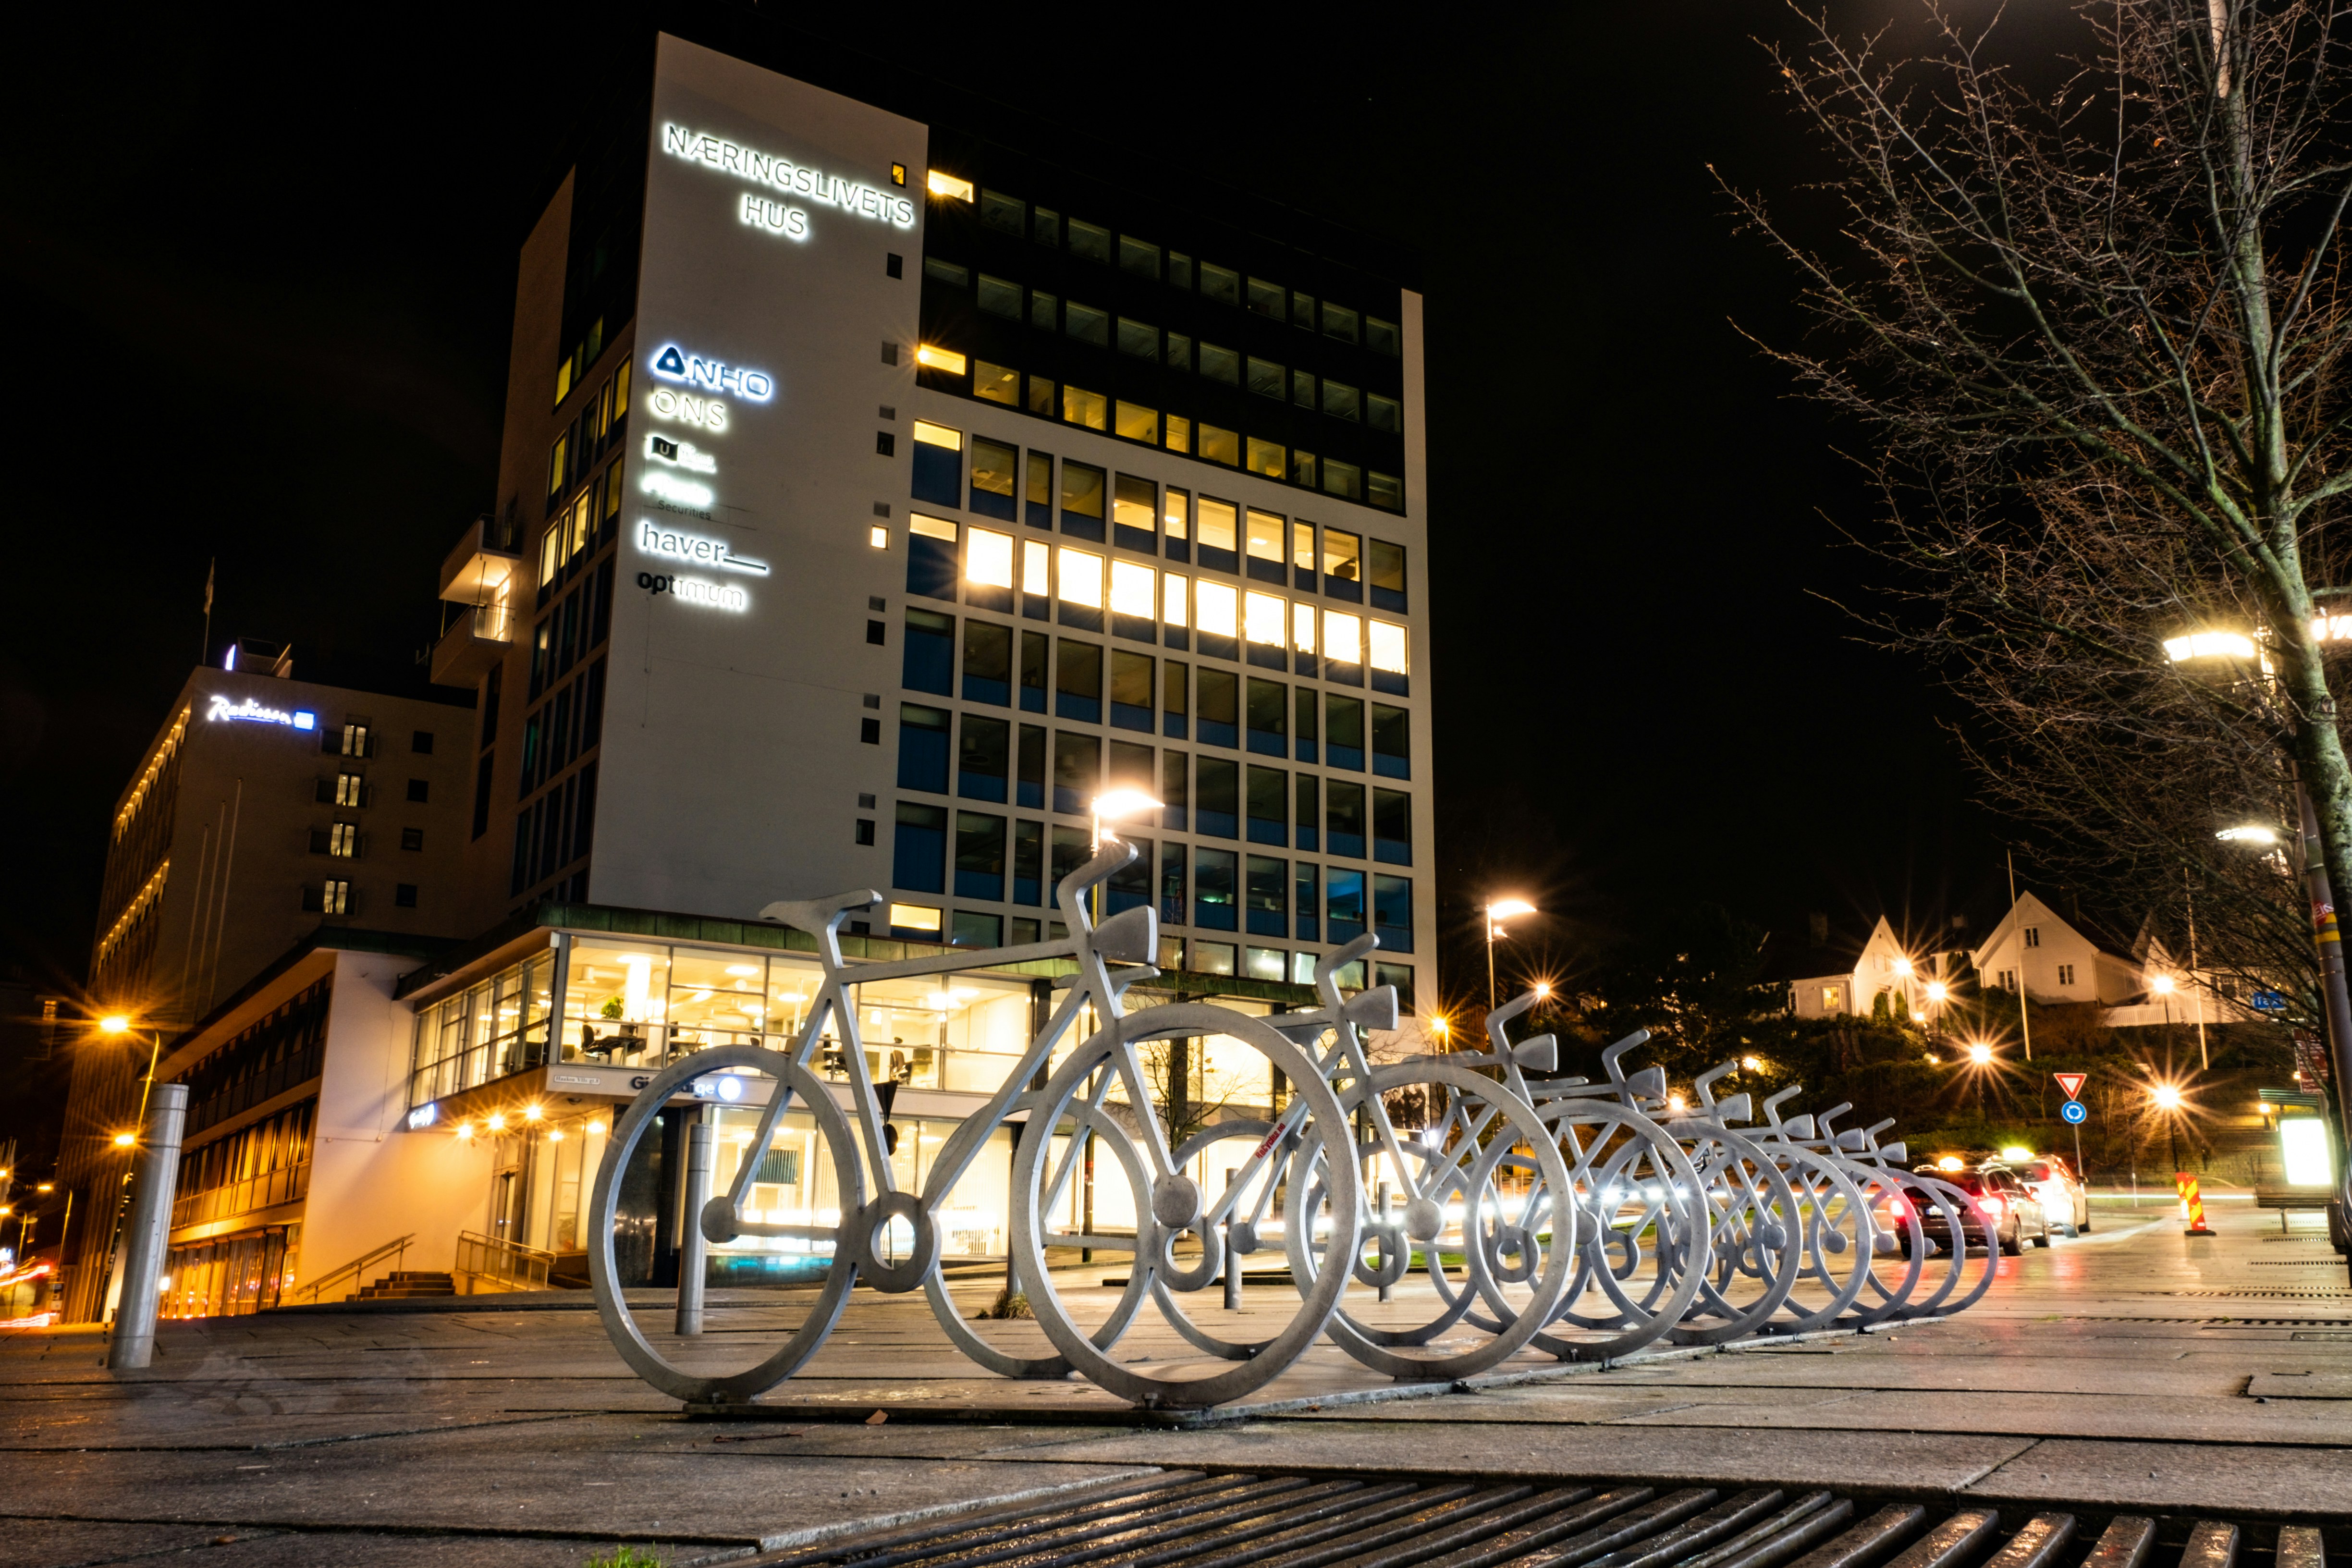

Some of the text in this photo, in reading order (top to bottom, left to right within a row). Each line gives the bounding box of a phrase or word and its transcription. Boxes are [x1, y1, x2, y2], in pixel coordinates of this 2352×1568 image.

[667, 125, 913, 224] NÆRINGSLIVETS
[746, 196, 805, 235] HUS
[692, 358, 770, 396] NHO
[655, 391, 724, 426] ONS
[658, 500, 711, 521] Securities
[642, 523, 725, 562] haver
[637, 572, 743, 607] optimum
[207, 696, 293, 725] Radisson
